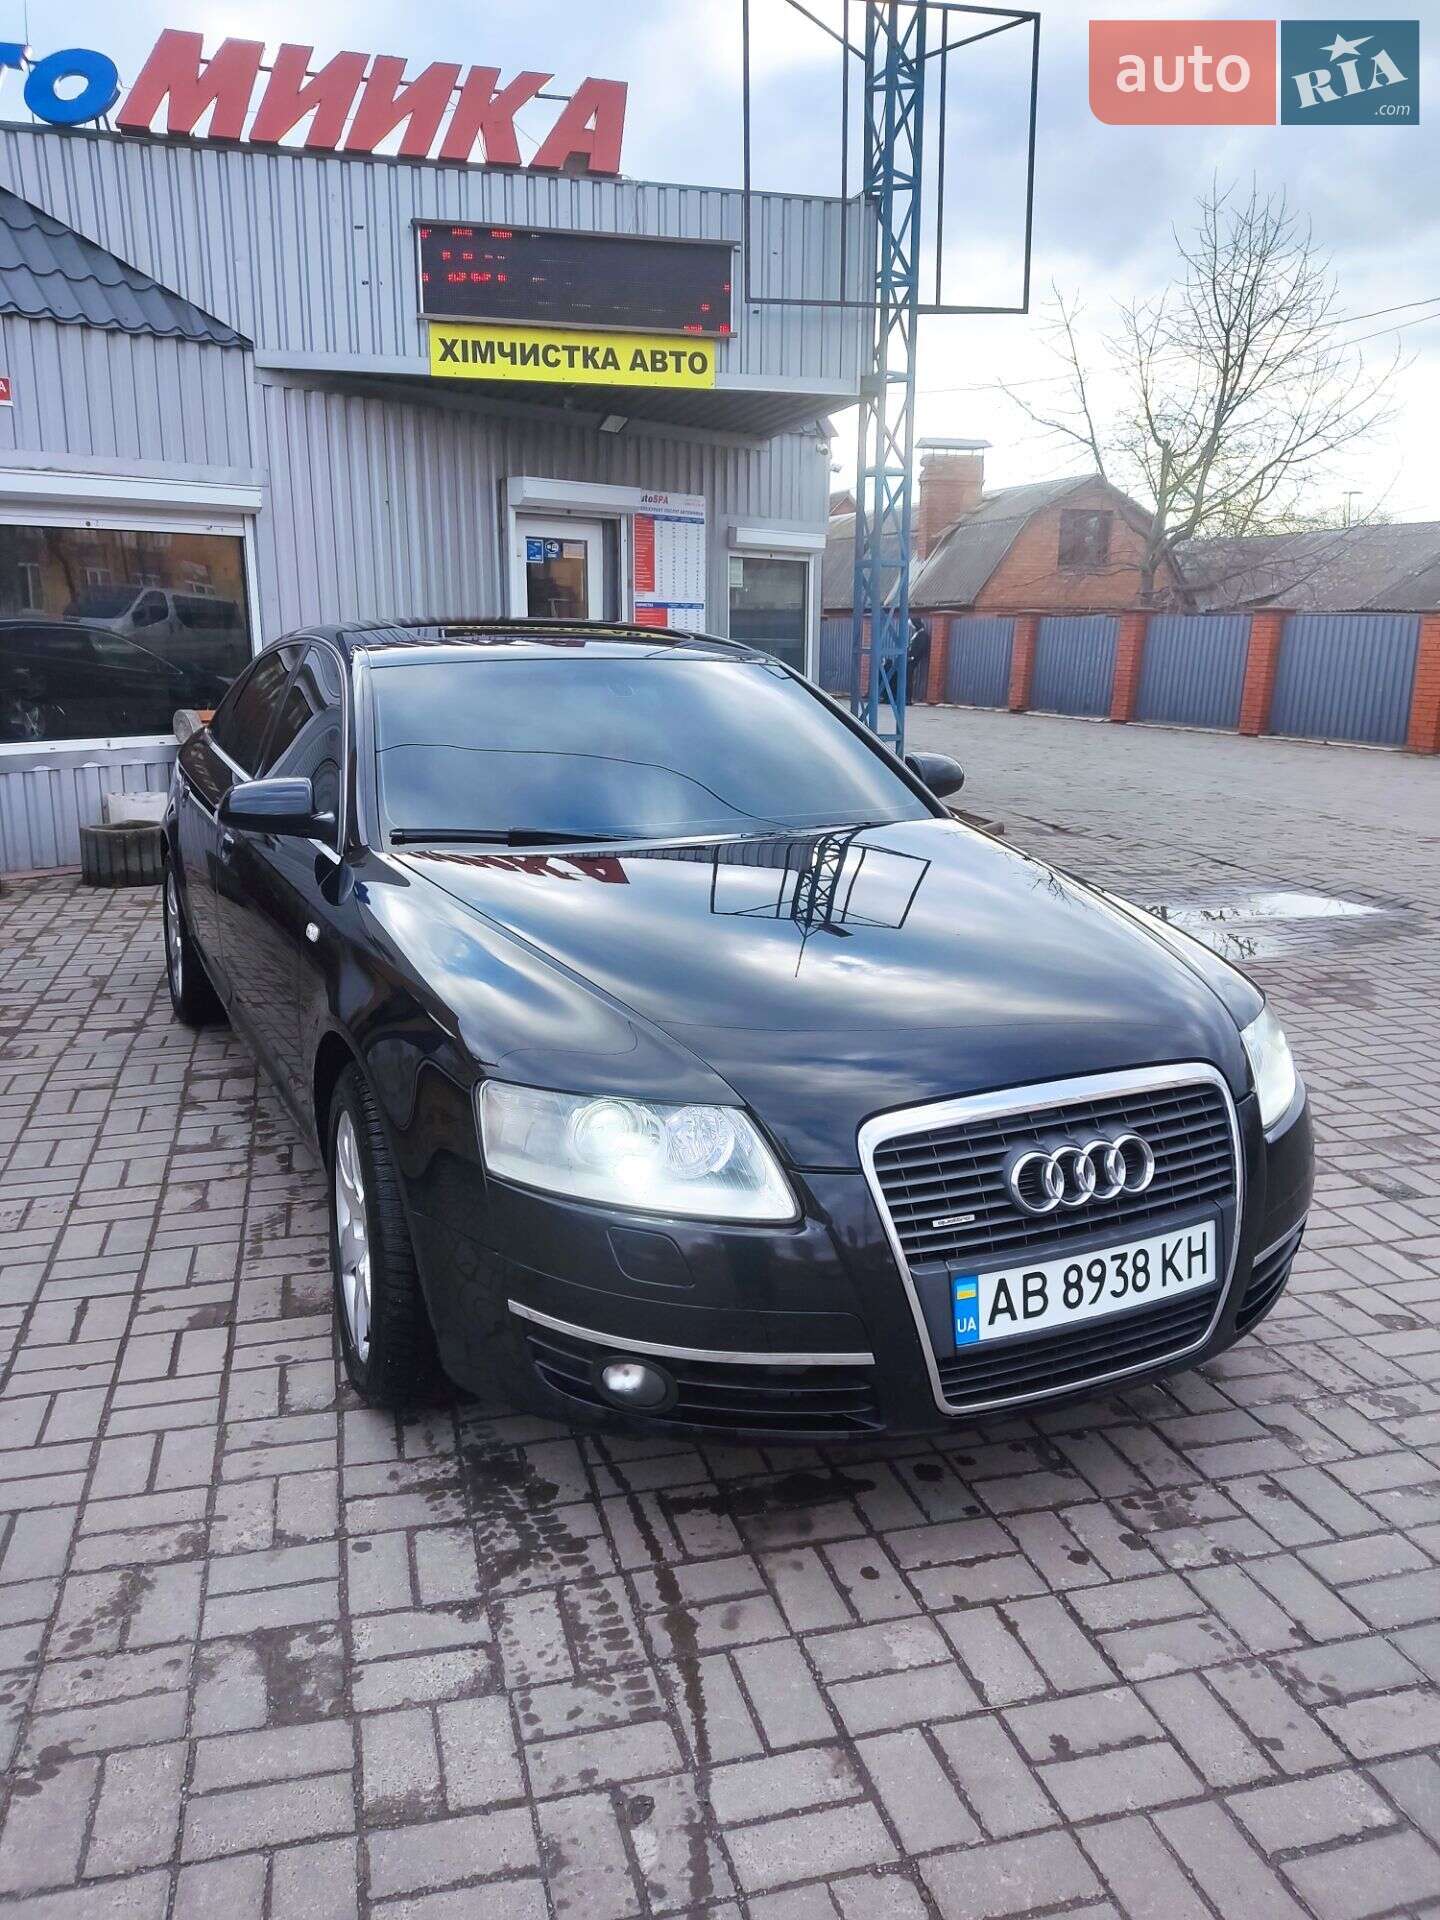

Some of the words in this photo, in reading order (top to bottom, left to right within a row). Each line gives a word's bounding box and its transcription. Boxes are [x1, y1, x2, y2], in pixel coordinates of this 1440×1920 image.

[438, 337, 621, 371] ХІМЧИСТКА
[628, 349, 709, 375] АВТО
[987, 1271, 1049, 1326] AB
[1062, 1248, 1151, 1310] 8938
[1160, 1231, 1208, 1287] KH
[957, 1314, 977, 1333] UA
